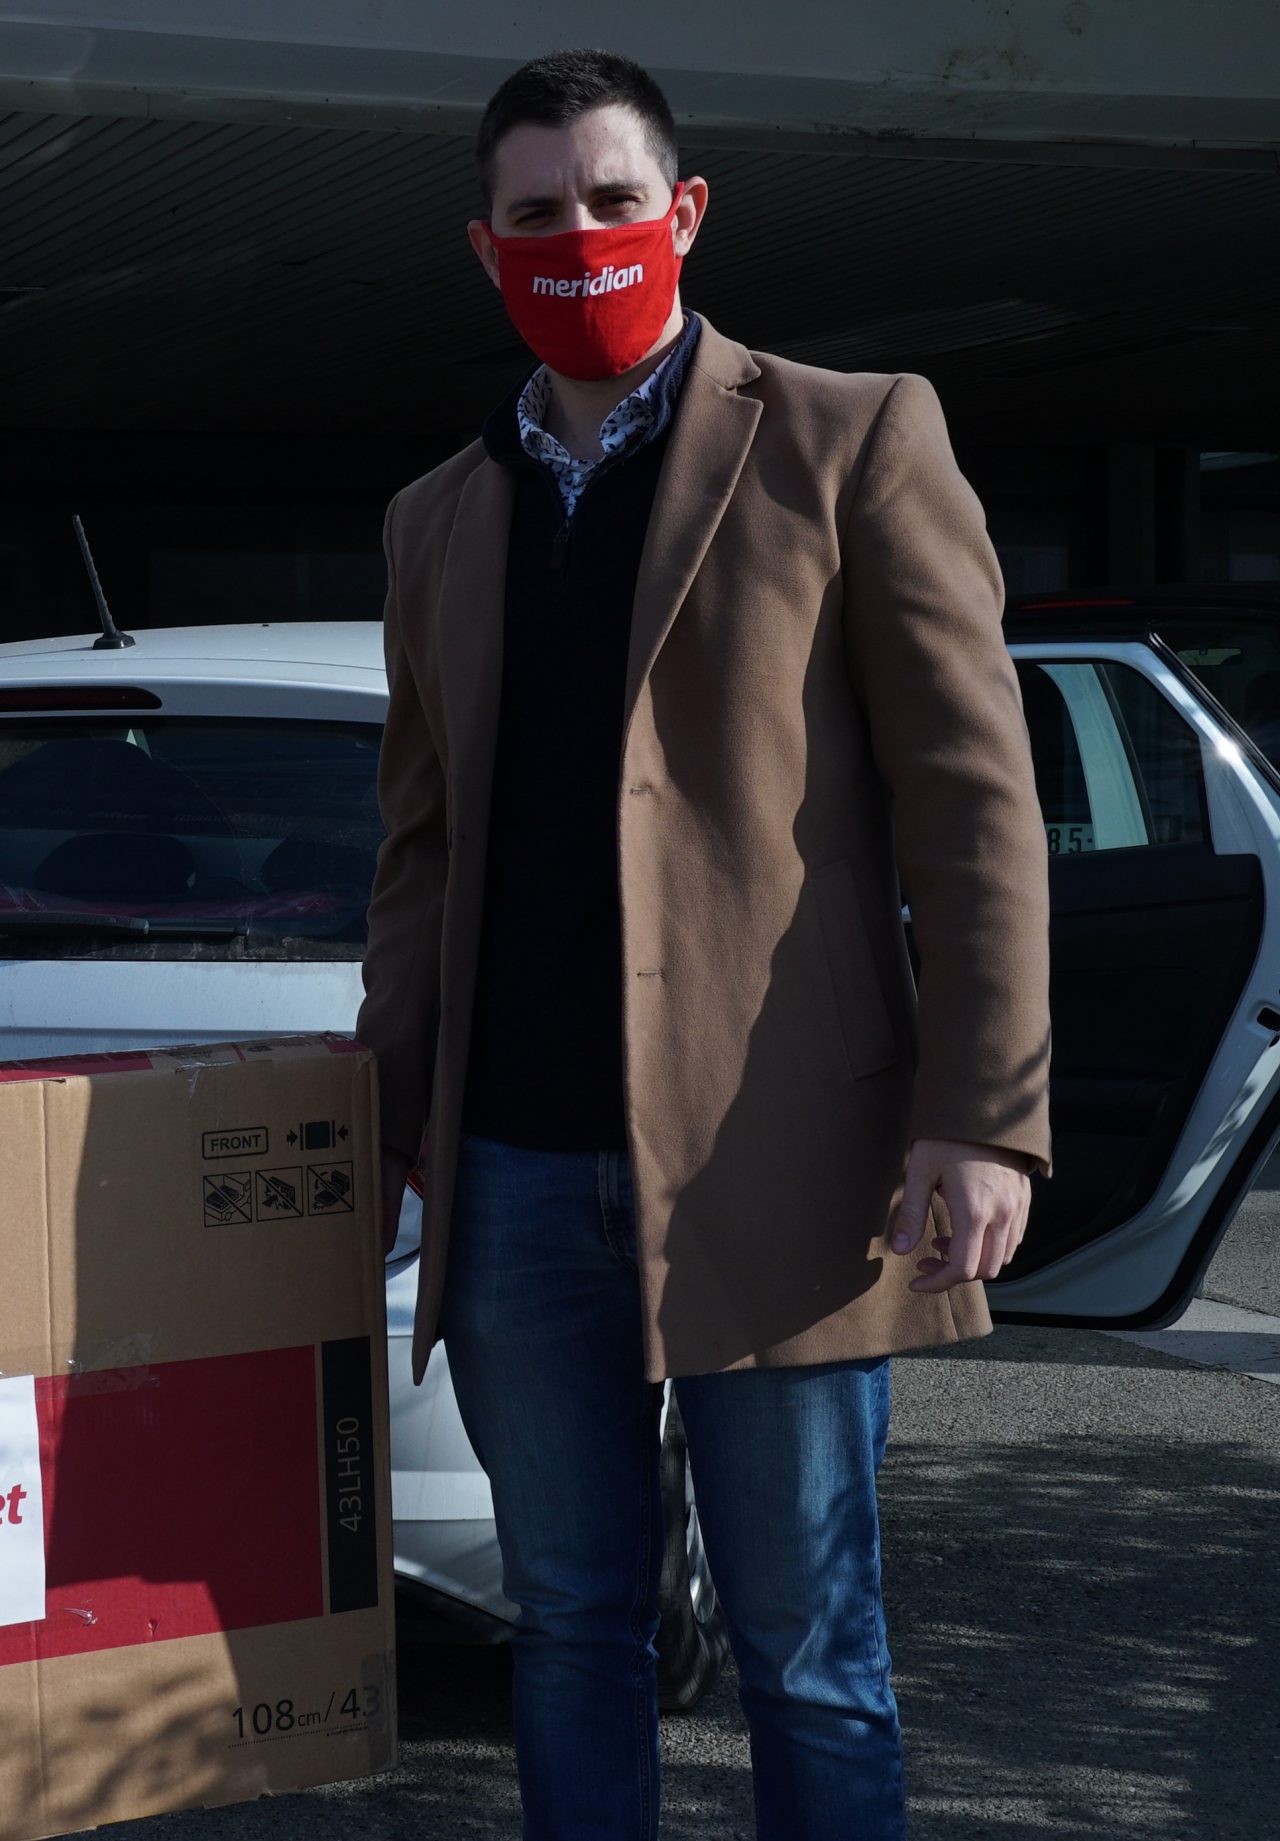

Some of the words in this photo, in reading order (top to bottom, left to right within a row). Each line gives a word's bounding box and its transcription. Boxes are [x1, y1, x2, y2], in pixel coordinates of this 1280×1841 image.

[533, 263, 643, 298] meridian
[210, 1134, 261, 1151] FRONT
[336, 1417, 363, 1532] 43LH50
